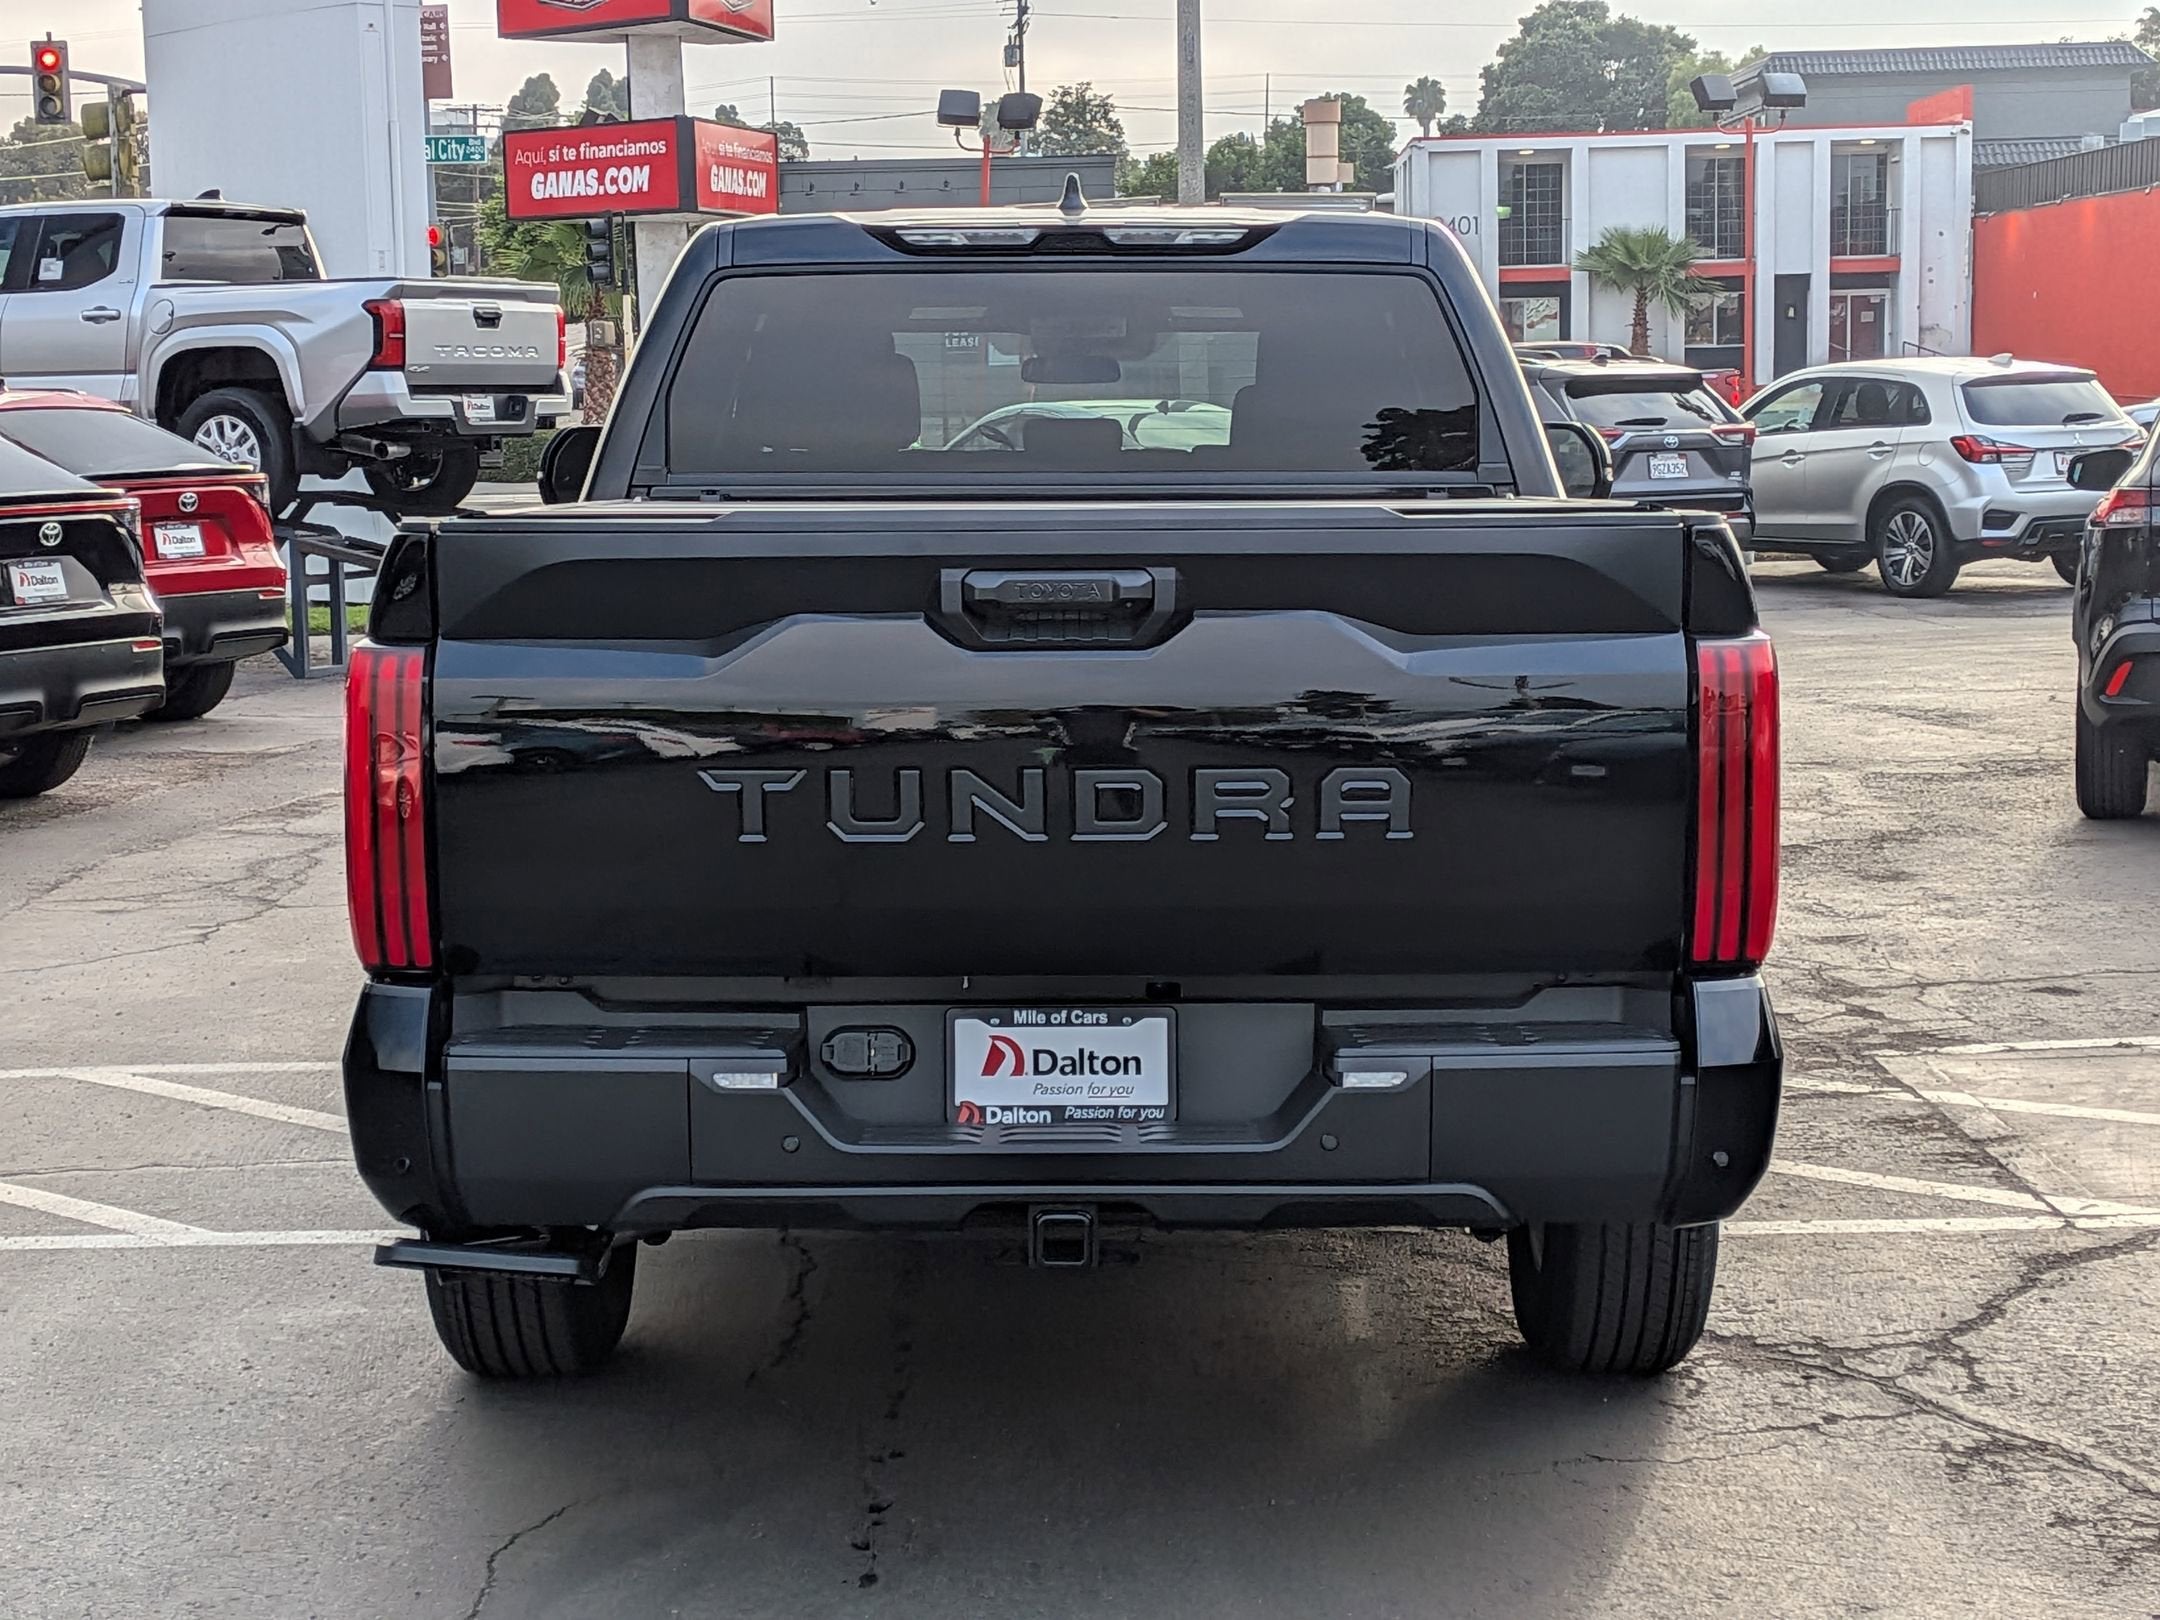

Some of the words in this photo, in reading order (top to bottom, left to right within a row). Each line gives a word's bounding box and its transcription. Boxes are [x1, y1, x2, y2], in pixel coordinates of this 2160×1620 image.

[438, 139, 466, 161] City
[562, 145, 577, 162] te
[579, 138, 667, 160] financiamos
[531, 164, 650, 200] GANAS.COM
[710, 163, 767, 199] GANAS.COM
[433, 344, 539, 358] TACOMA
[171, 534, 197, 546] Dalton
[30, 574, 59, 587] Dalton
[1013, 582, 1101, 600] TOYOTA
[697, 766, 1414, 843] TUNDRA
[1013, 1010, 1046, 1025] Mile
[1050, 1010, 1067, 1024] of
[1070, 1010, 1108, 1025] Cars
[1032, 1047, 1142, 1076] Dalton
[1032, 1082, 1083, 1096] Passion
[1087, 1081, 1108, 1097] for
[1109, 1084, 1135, 1098] you
[986, 1106, 1052, 1124] Dalton
[1064, 1106, 1114, 1120] Passion
[1116, 1106, 1136, 1120] for
[1136, 1108, 1165, 1122] you
